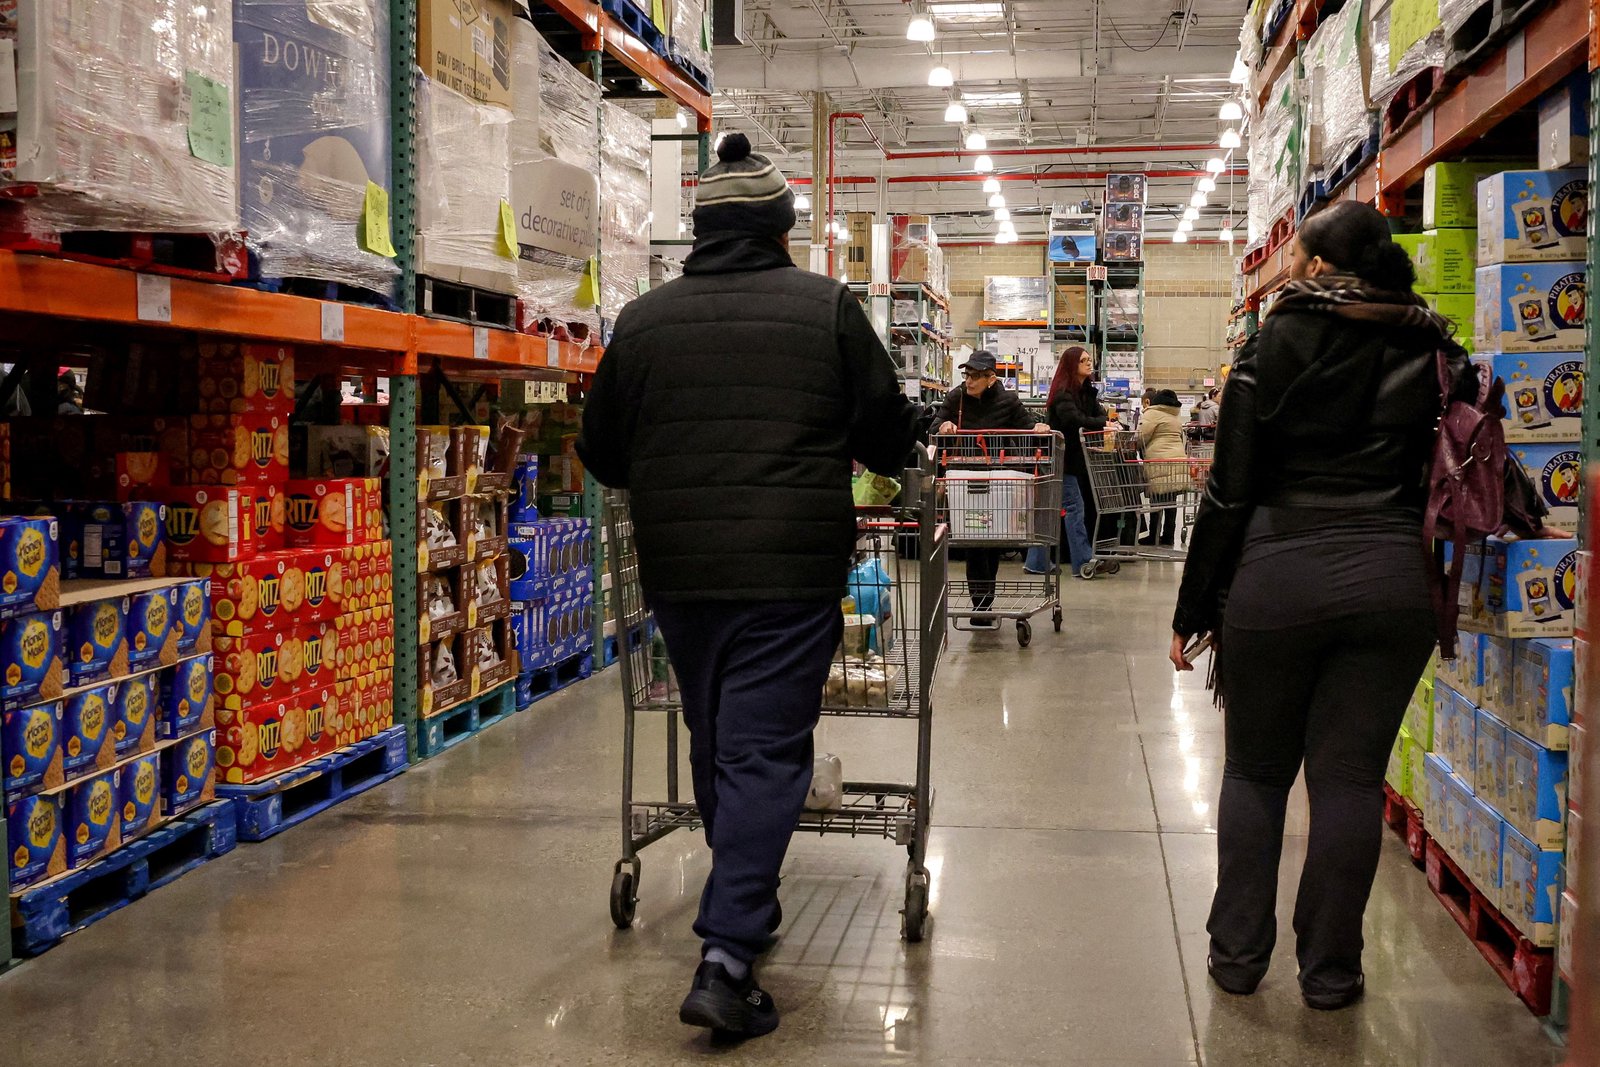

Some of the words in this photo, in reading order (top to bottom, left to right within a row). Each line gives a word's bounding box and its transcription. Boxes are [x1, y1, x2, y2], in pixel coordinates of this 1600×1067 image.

[262, 32, 338, 89] DOWN
[452, 76, 462, 92] NET
[1552, 182, 1584, 206] PIRATE'S
[560, 190, 575, 209] set
[576, 191, 587, 212] of
[585, 199, 590, 220] 3
[521, 206, 579, 242] decorative
[1088, 267, 1096, 279] 102
[1097, 267, 1105, 279] 103
[878, 284, 887, 294] 101
[1550, 274, 1580, 300] PIRATE'S
[259, 361, 280, 390] RITZ
[1545, 363, 1576, 388] PIRATE'S
[251, 431, 274, 459] RITZ
[1543, 453, 1574, 477] PIRATE'S
[284, 497, 319, 524] RITZ
[18, 537, 42, 557] Honey
[430, 552, 445, 562] SWEET
[22, 552, 41, 568] Maid
[258, 578, 280, 609] RITZ
[305, 571, 326, 600] RITZ
[147, 604, 165, 621] Honey
[185, 595, 201, 611] Honey
[23, 631, 45, 651] Honey
[28, 645, 45, 662] Maid
[304, 639, 322, 669] RITZ
[256, 651, 278, 682] RITZ
[128, 692, 145, 710] Honey
[82, 704, 102, 724] Honey
[306, 707, 324, 737] RITZ
[26, 720, 49, 740] Honey
[86, 716, 101, 733] Maid
[32, 734, 49, 752] Maid
[259, 722, 281, 754] RITZ
[190, 748, 205, 765] Honey
[136, 772, 152, 788] Honey
[90, 791, 109, 810] Honey
[94, 802, 108, 818] Maid
[30, 809, 52, 831] Honey
[34, 822, 52, 841] Maid
